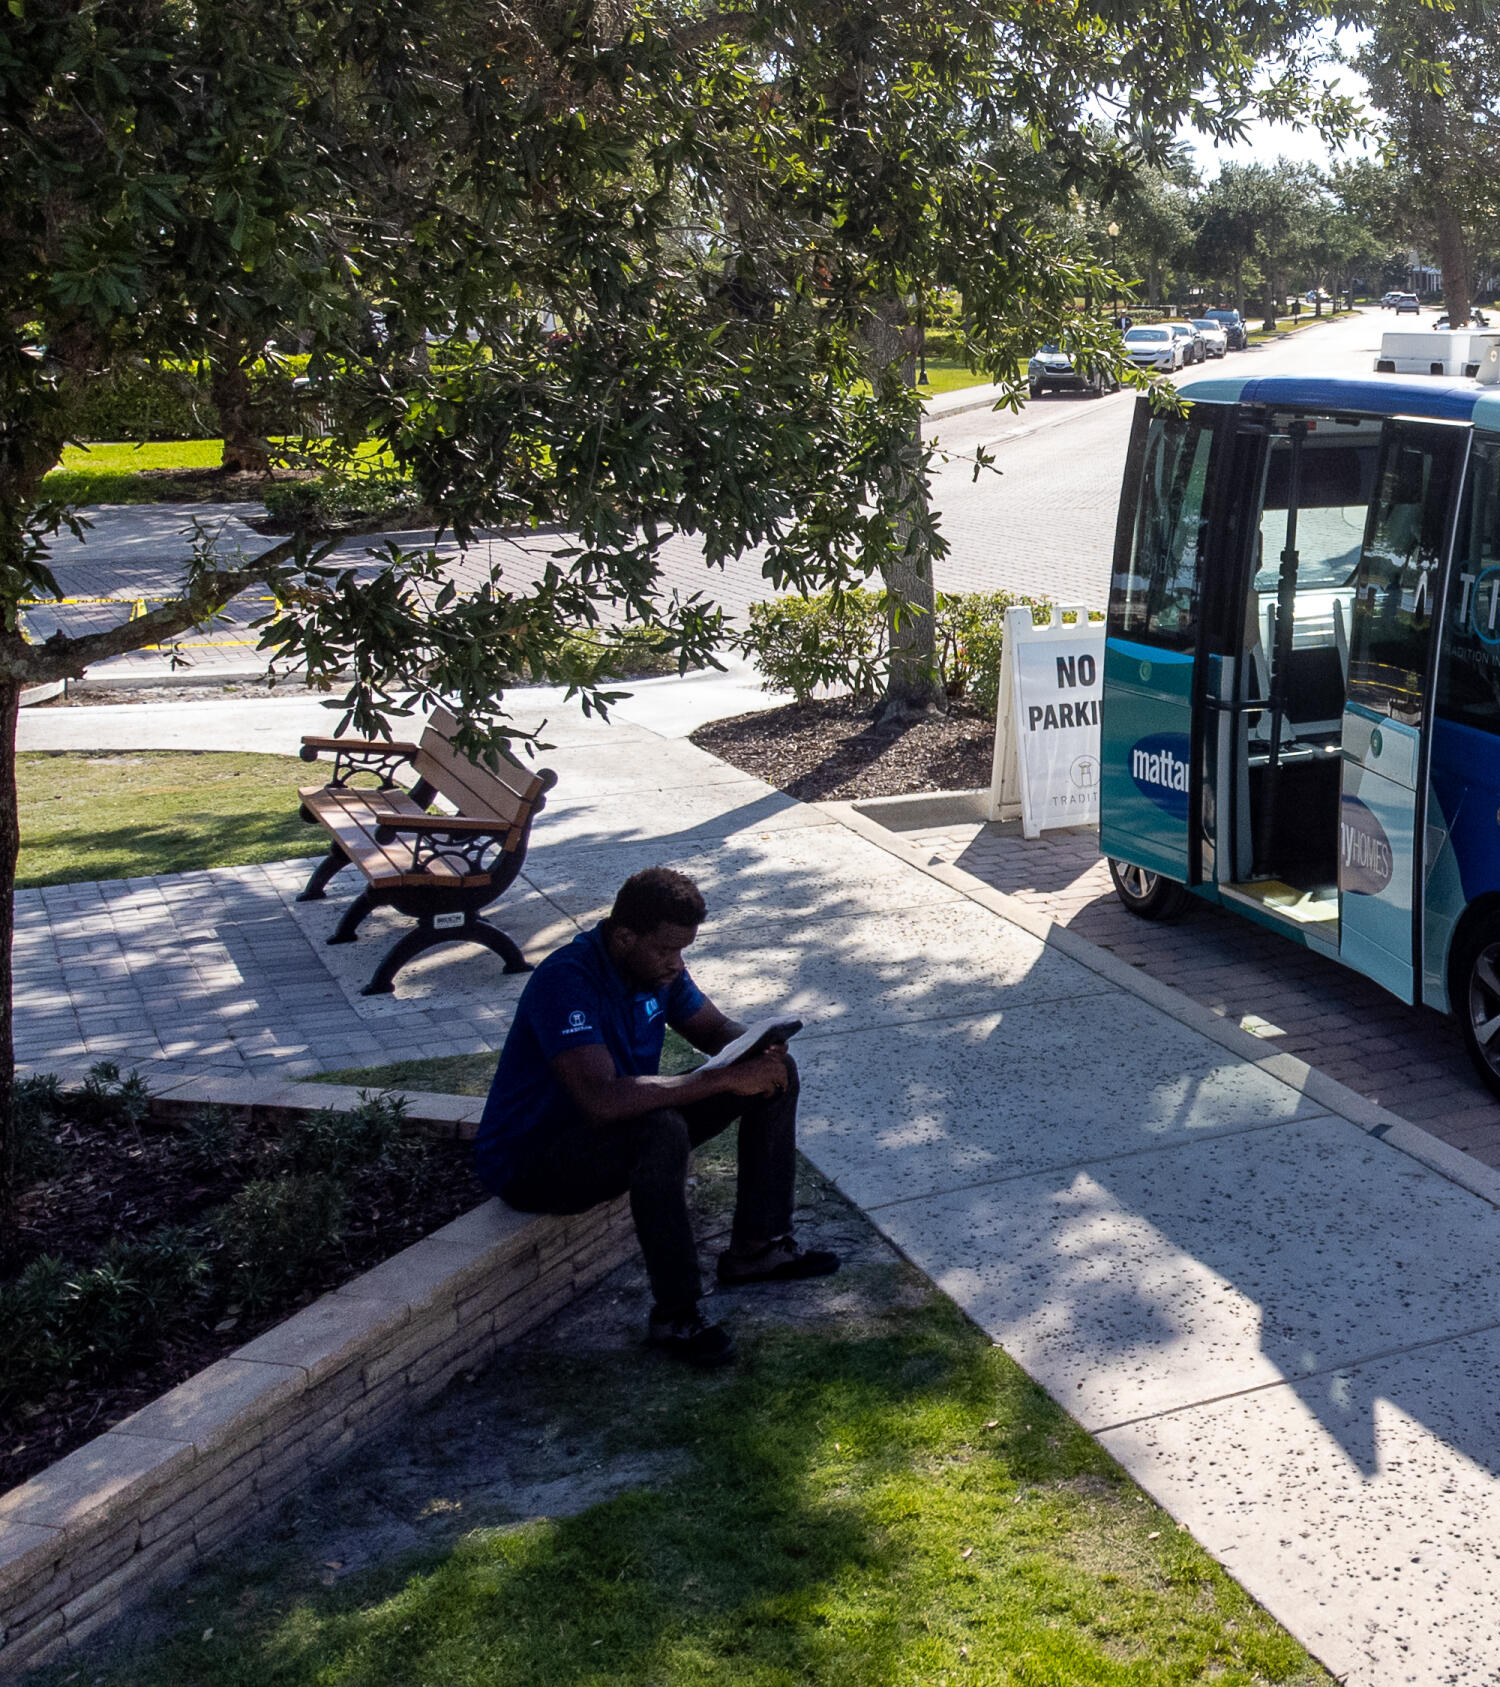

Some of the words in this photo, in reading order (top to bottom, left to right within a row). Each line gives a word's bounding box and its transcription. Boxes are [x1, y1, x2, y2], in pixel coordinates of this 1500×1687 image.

[1056, 654, 1096, 688] NO
[1028, 700, 1103, 731] PARKI
[1052, 791, 1098, 807] TRADIT
